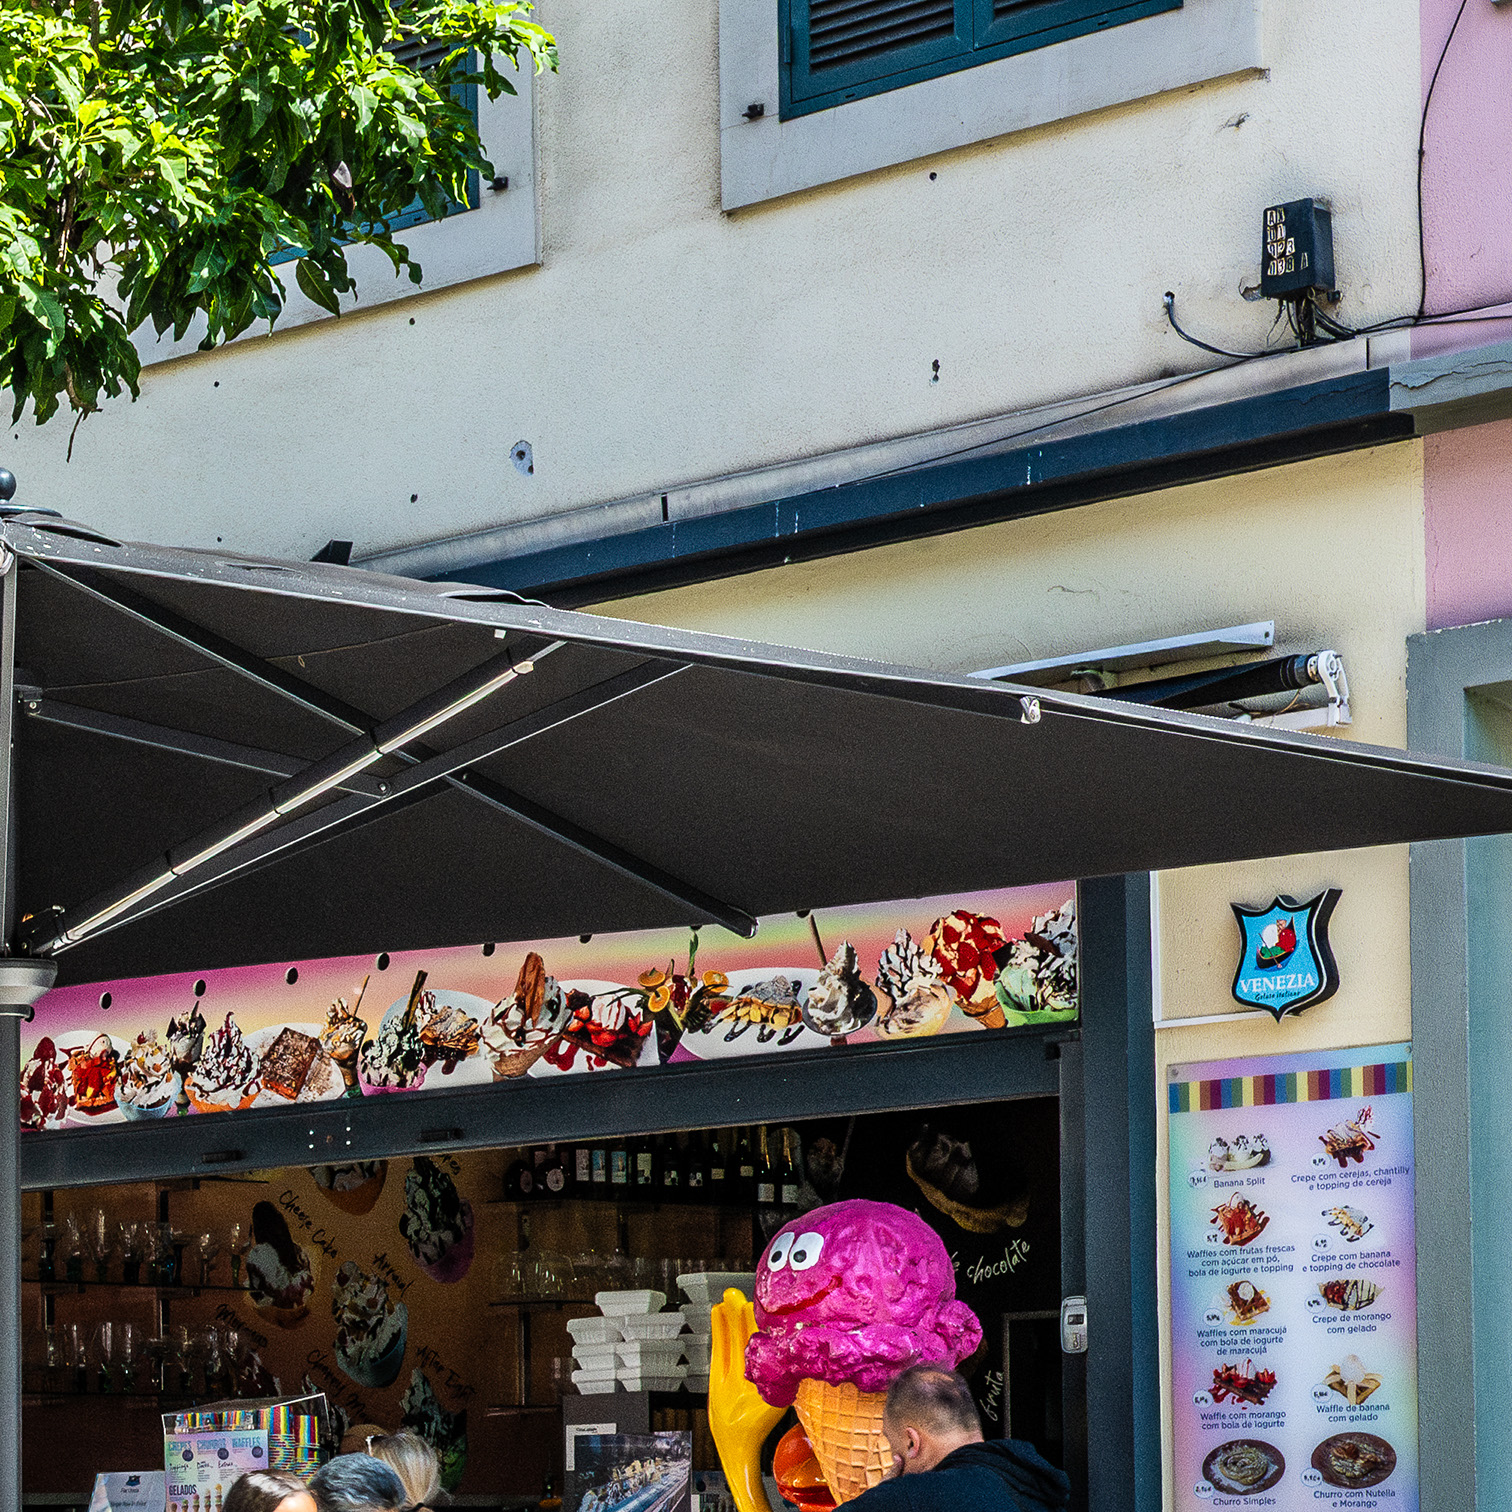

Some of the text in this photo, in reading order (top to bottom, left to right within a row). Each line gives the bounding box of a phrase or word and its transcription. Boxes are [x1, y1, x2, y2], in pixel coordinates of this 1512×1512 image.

[1240, 972, 1316, 994] VENEZIA
[1291, 1174, 1316, 1183] Crepe
[1339, 1170, 1371, 1179] cerejas,
[1373, 1166, 1410, 1177] chantilly
[1213, 1179, 1244, 1188] Banana
[1246, 1177, 1266, 1186] Split
[1316, 1181, 1350, 1191] topping
[1366, 1177, 1392, 1187] cereja
[1187, 1250, 1217, 1258] Waffles
[1239, 1247, 1263, 1255] frutas
[1265, 1245, 1295, 1253] frescas
[1311, 1254, 1336, 1263] Crepe
[1360, 1250, 1391, 1259] banana
[966, 1238, 1031, 1284] chocolate
[1309, 1262, 1343, 1272] topping
[1345, 1261, 1356, 1269] de
[1358, 1259, 1401, 1268] chocolate
[1188, 1268, 1206, 1277] bola
[1208, 1268, 1219, 1276] de
[1221, 1267, 1251, 1276] iogurte
[1260, 1264, 1294, 1273] topping
[1312, 1313, 1391, 1324] Crepe de morango
[1196, 1326, 1287, 1338] Waffles com maracujá
[1327, 1324, 1377, 1334] com gelado
[1220, 1338, 1238, 1346] bola
[1240, 1337, 1251, 1345] de
[1216, 1348, 1227, 1356] de
[979, 1369, 1004, 1422] fruta
[1316, 1403, 1390, 1413] Waffle de banana
[1200, 1412, 1227, 1420] Waffle
[1249, 1411, 1286, 1420] morango
[1328, 1413, 1378, 1423] com gelado
[1201, 1422, 1220, 1430] com
[1221, 1420, 1240, 1429] bola
[1242, 1420, 1253, 1428] de
[232, 1437, 261, 1448] WAFFLES
[169, 1484, 197, 1496] GELADOS
[1313, 1489, 1395, 1498] Churro com Nutella
[1212, 1497, 1276, 1506] Churro Simples
[1340, 1500, 1377, 1509] Morango
